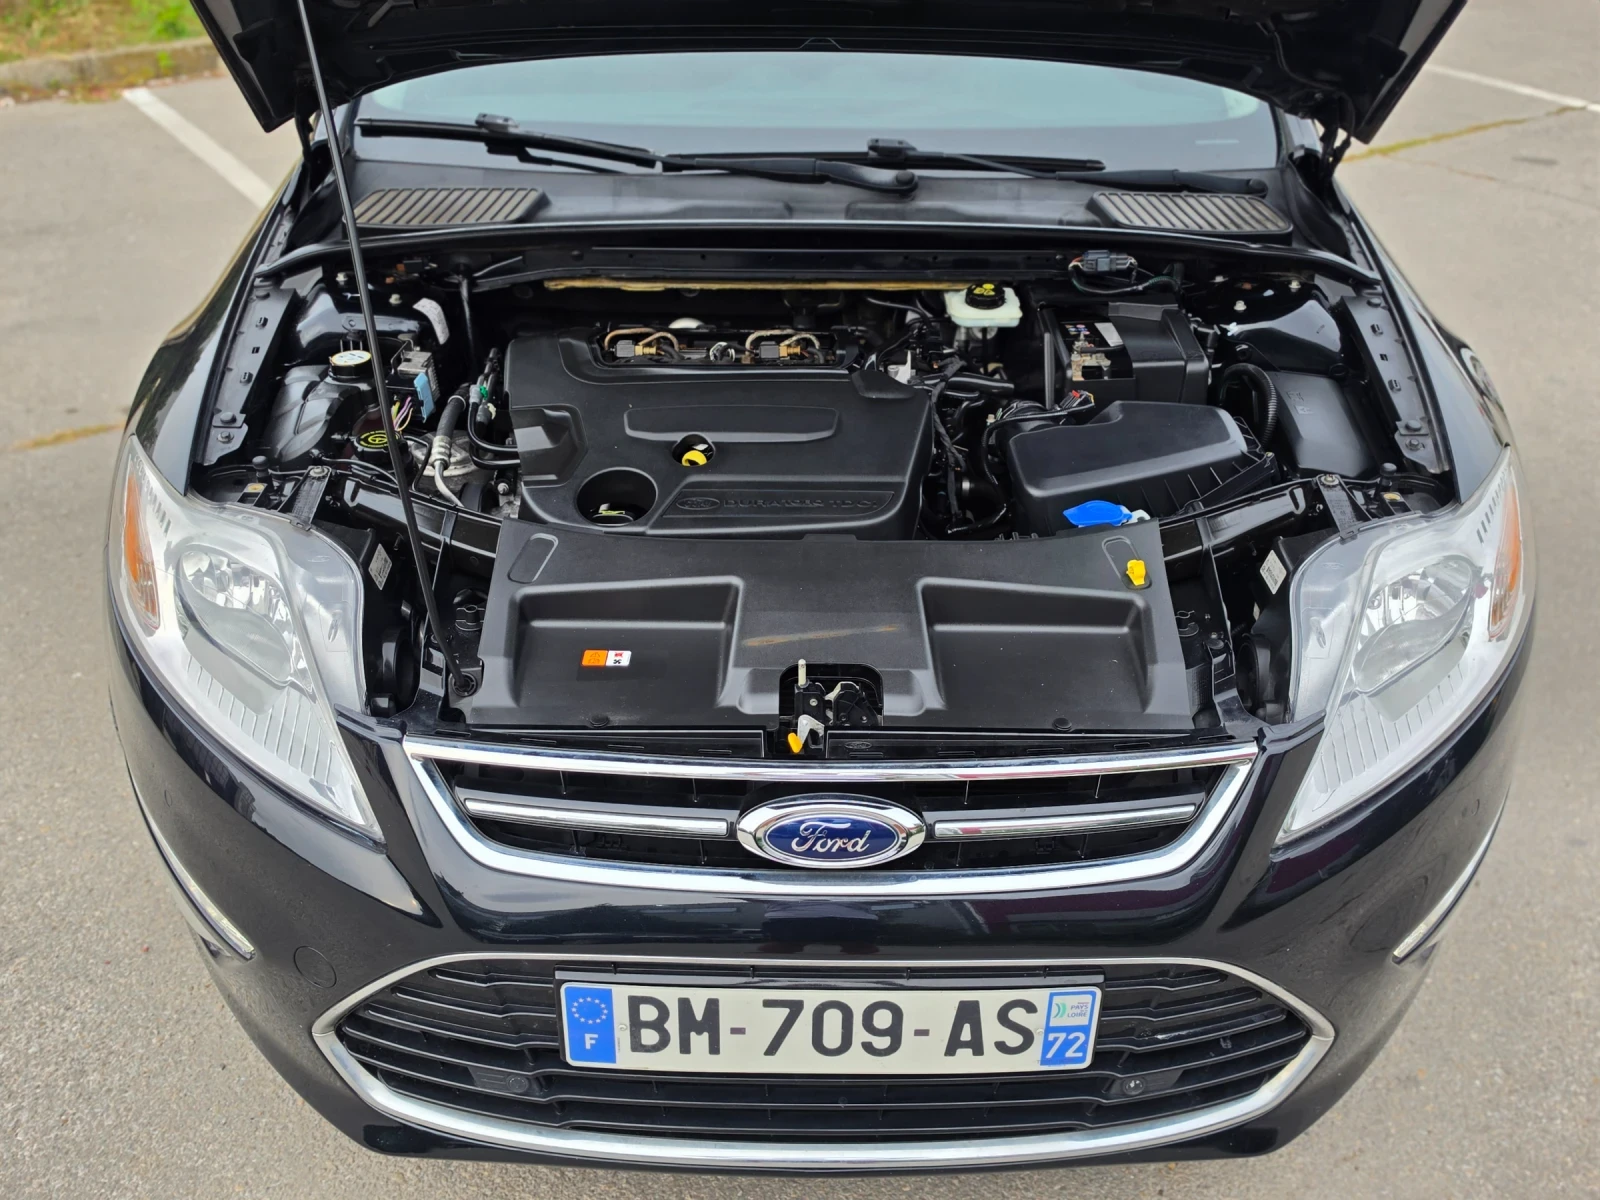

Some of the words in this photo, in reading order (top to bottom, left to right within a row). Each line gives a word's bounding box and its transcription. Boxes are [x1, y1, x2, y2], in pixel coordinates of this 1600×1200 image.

[791, 821, 871, 853] Ford
[627, 994, 1039, 1058] BM-709-AS
[585, 1033, 599, 1050] F
[1045, 1032, 1085, 1058] 72
